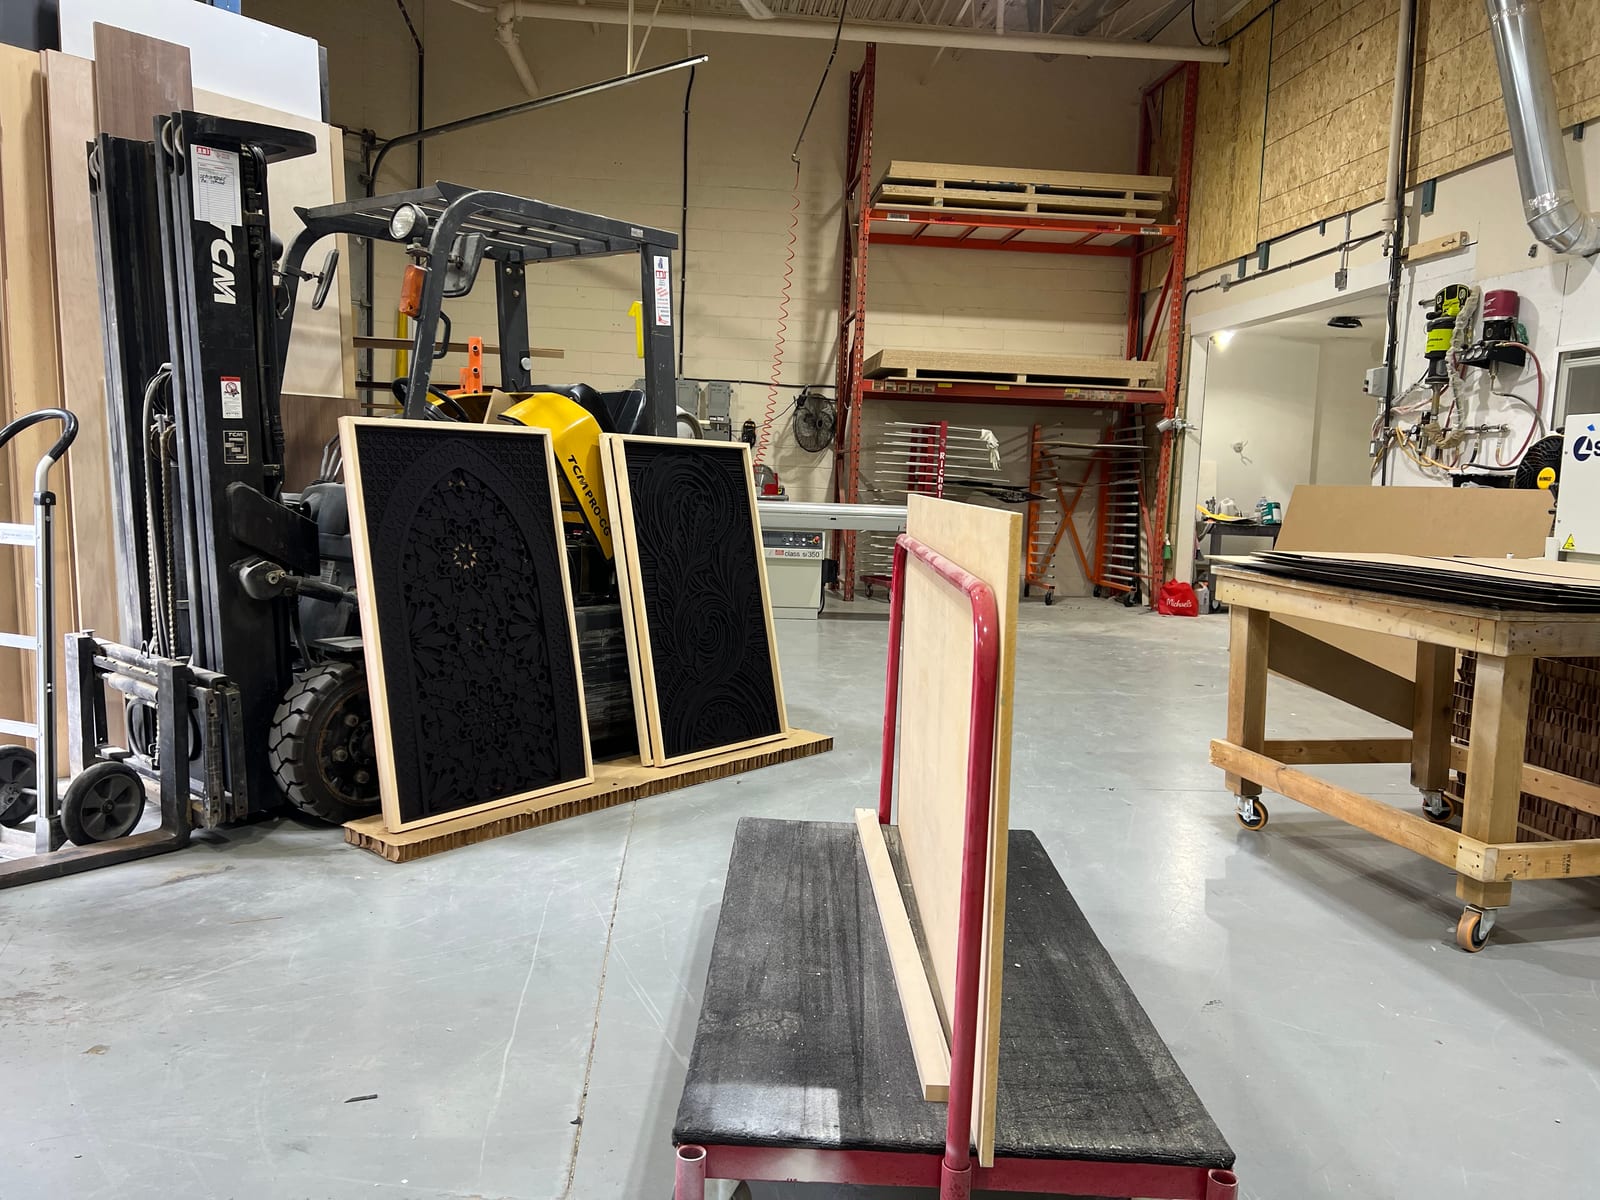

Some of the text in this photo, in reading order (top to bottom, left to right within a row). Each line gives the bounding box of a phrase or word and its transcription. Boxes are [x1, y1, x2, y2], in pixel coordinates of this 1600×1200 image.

[210, 222, 236, 304] TCM
[568, 455, 610, 536] TCM PRO-CG
